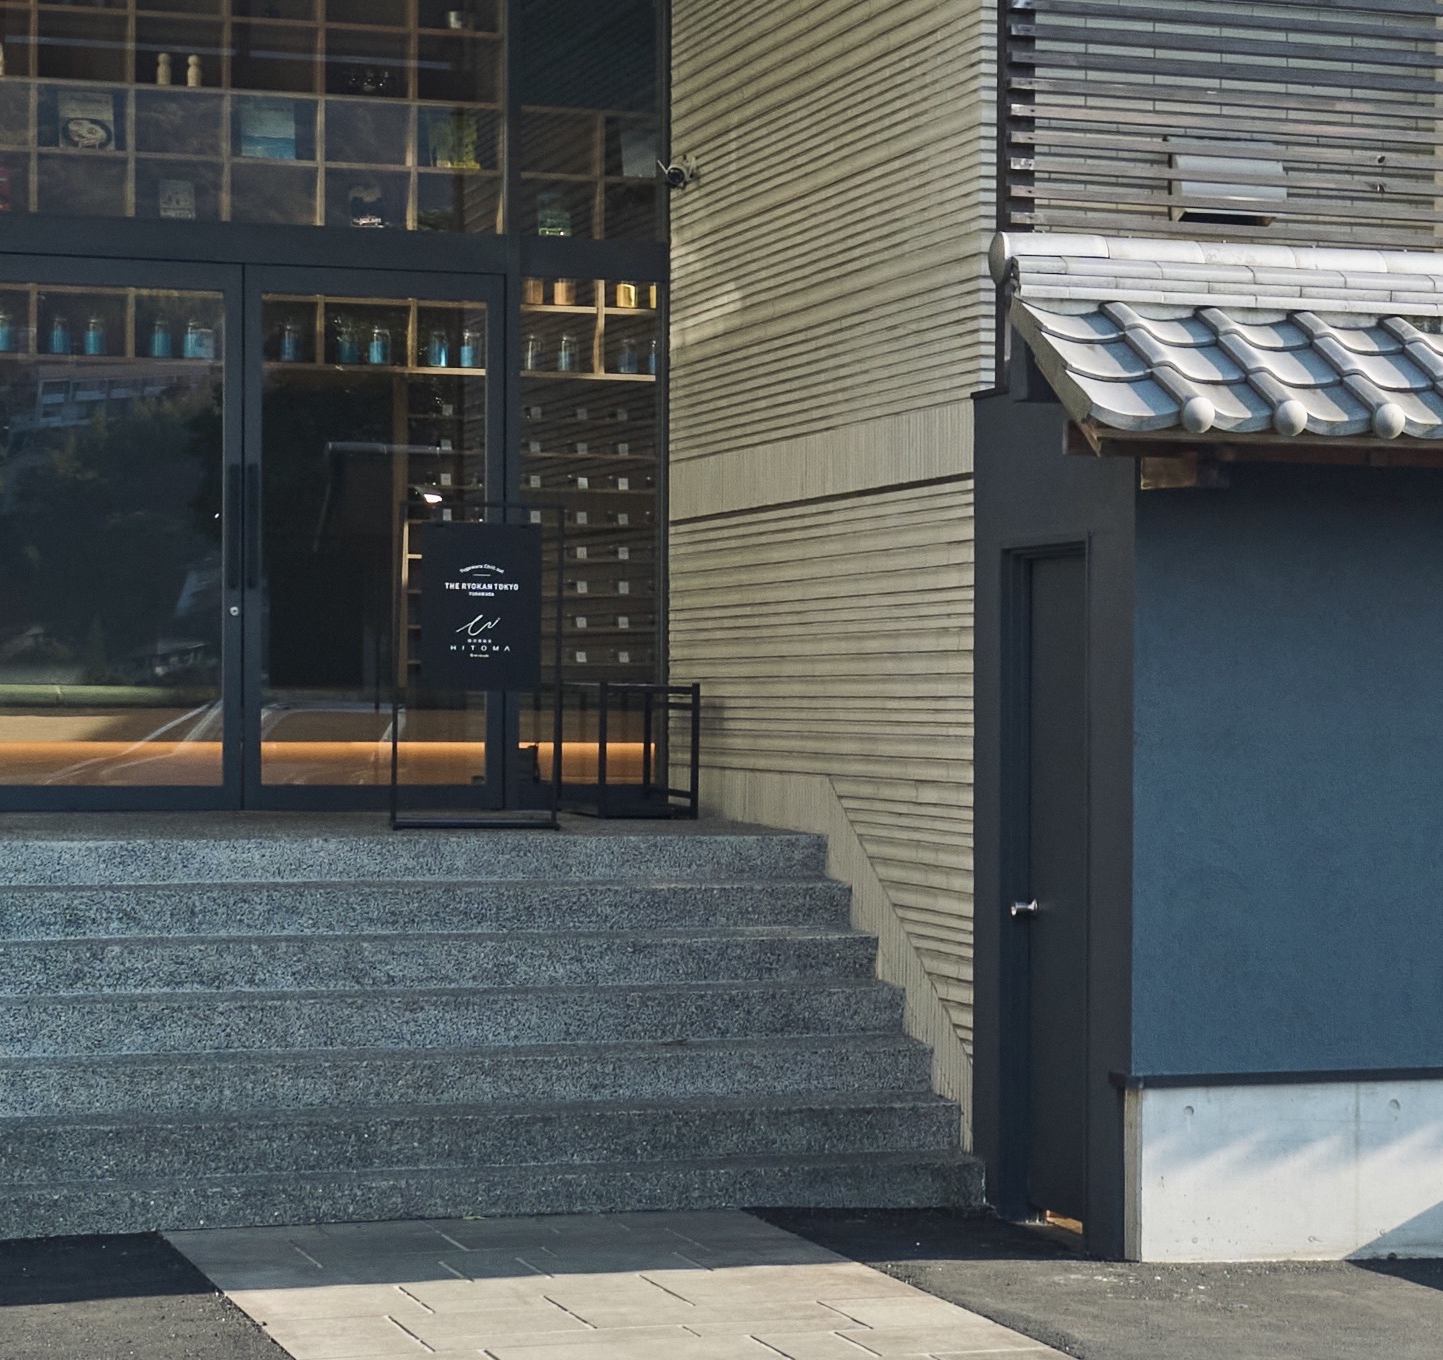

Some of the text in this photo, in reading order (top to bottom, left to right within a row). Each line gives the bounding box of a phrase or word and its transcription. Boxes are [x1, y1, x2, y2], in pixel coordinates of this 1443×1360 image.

[444, 582, 519, 591] THE RYOKAN TOKYO
